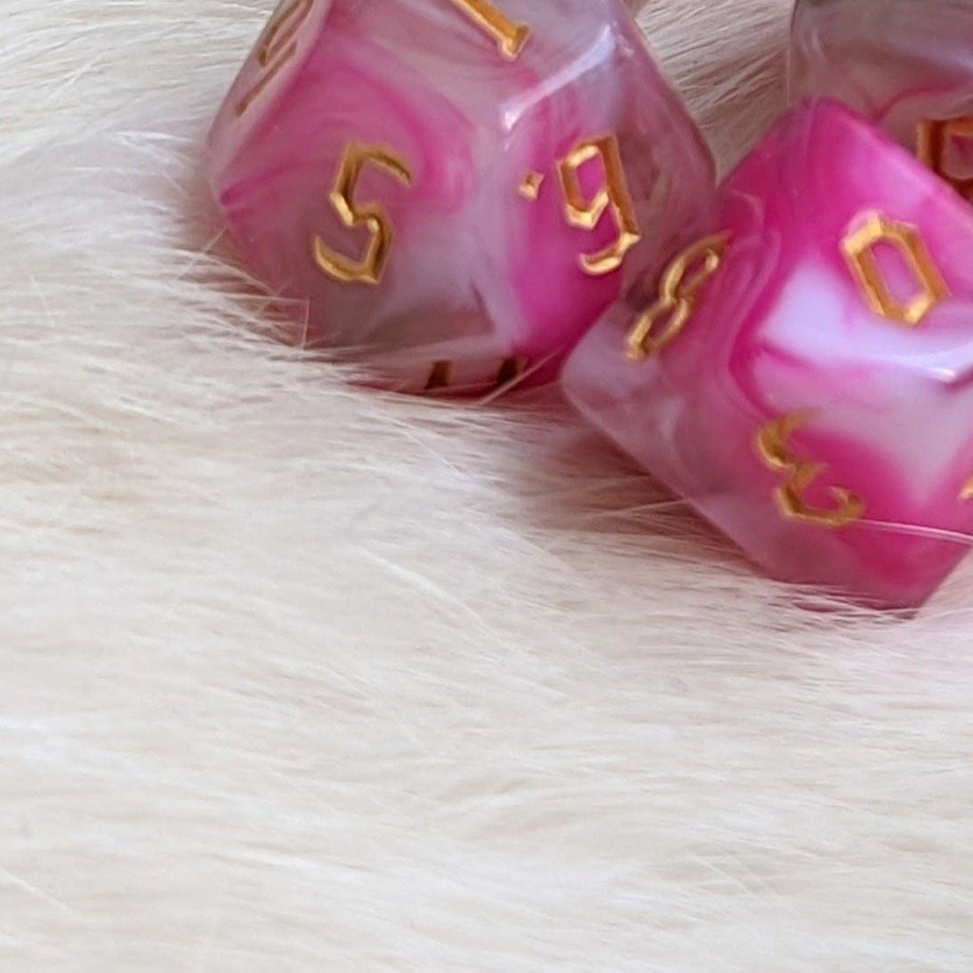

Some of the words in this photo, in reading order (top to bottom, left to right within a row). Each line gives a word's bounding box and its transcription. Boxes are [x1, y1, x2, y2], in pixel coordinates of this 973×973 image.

[314, 139, 413, 285] 5
[840, 210, 951, 327] 0
[626, 230, 732, 361] 8
